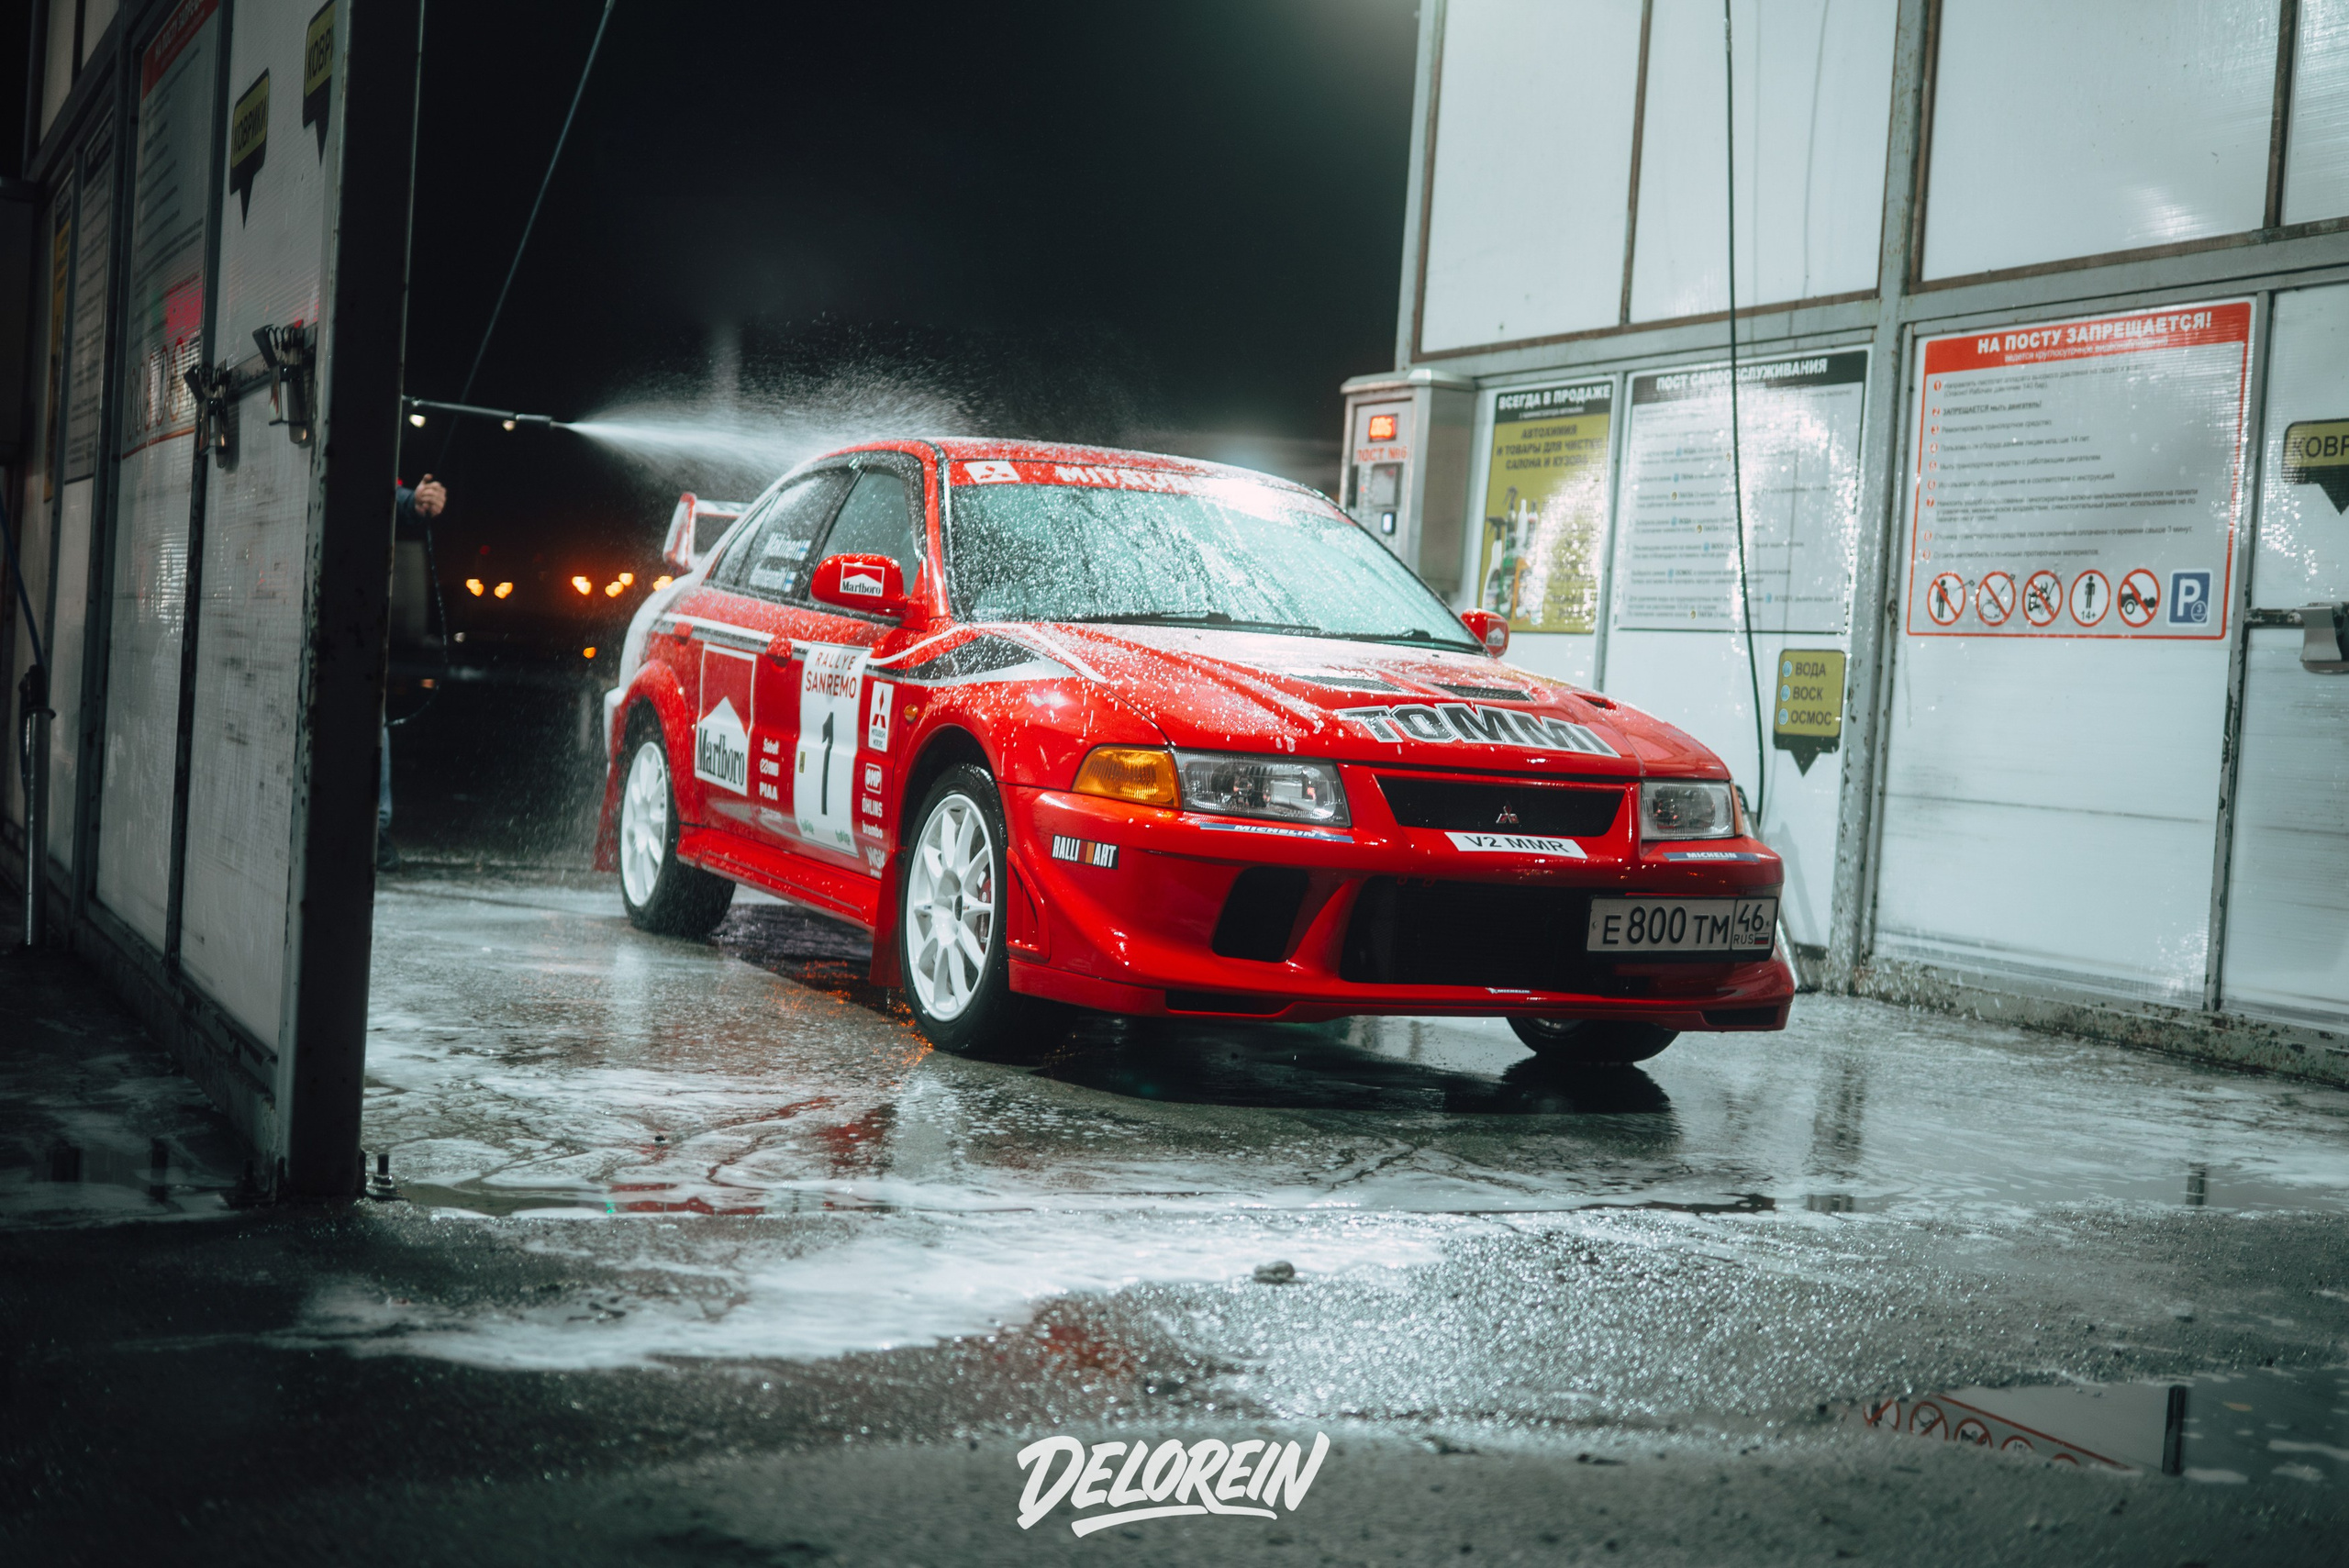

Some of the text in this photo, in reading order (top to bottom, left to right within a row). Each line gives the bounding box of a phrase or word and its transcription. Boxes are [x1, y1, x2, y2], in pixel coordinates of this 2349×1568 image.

[1977, 311, 2212, 354] НА ПОСТУ ЗАПРЕЩАЕТСЯ!
[1655, 374, 1688, 393] ПОСТ
[1498, 384, 1612, 410] ВСЕГДА В ПРОДАЖЕ
[841, 581, 882, 595] Marlboro
[2177, 578, 2201, 617] P
[2081, 610, 2098, 620] 14+
[815, 651, 857, 671] RALLYE
[1795, 662, 1826, 680] ВОДА
[805, 670, 857, 699] SANREMO
[1792, 686, 1824, 701] ВОСК
[1790, 710, 1832, 727] ОСМОС
[1333, 703, 1621, 759] TOMMI
[696, 727, 745, 787] Marlboro
[821, 711, 834, 817] 1
[865, 768, 881, 788] OMP
[759, 781, 778, 802] PIAA
[862, 793, 883, 818] ÖHLINS
[862, 819, 883, 839] brembo
[1234, 825, 1317, 838] MICHELIN
[1464, 835, 1571, 853] V2 MMR
[1737, 904, 1763, 932] 46
[1733, 933, 1754, 945] RUS
